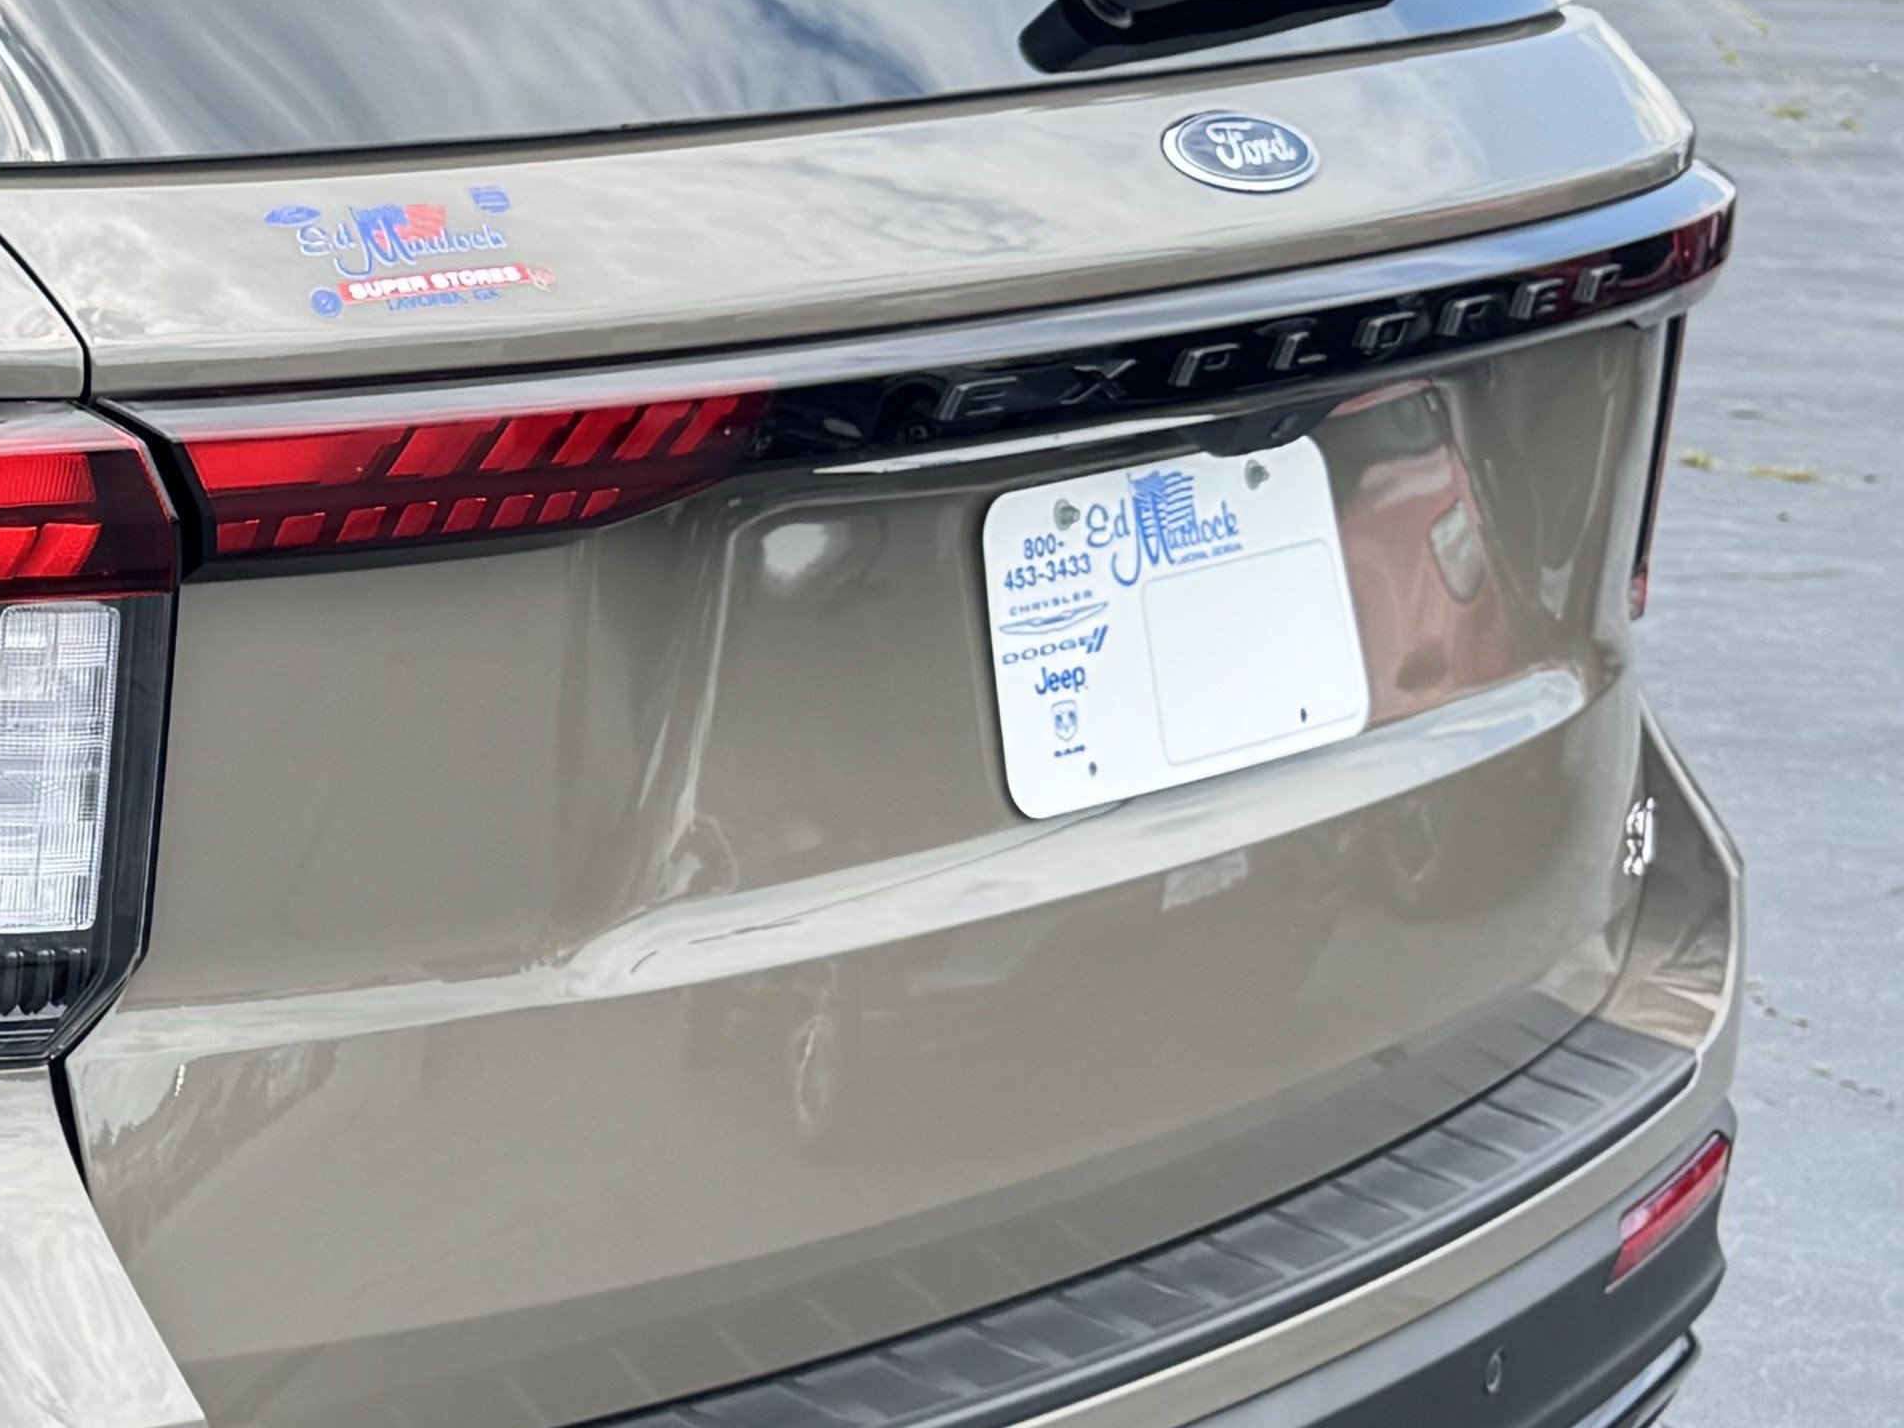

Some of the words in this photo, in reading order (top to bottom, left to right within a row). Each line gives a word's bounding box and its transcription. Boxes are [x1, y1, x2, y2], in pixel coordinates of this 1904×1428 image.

[1206, 121, 1297, 169] Ford
[348, 274, 429, 301] SUPER
[430, 264, 521, 290] STORES
[938, 262, 1622, 422] EXPLORER
[1086, 498, 1131, 549] Ed
[1023, 532, 1065, 560] 800-
[1004, 552, 1092, 592] 453-3433
[1008, 589, 1093, 616] CHRYSLER
[1034, 665, 1086, 696] Jeep
